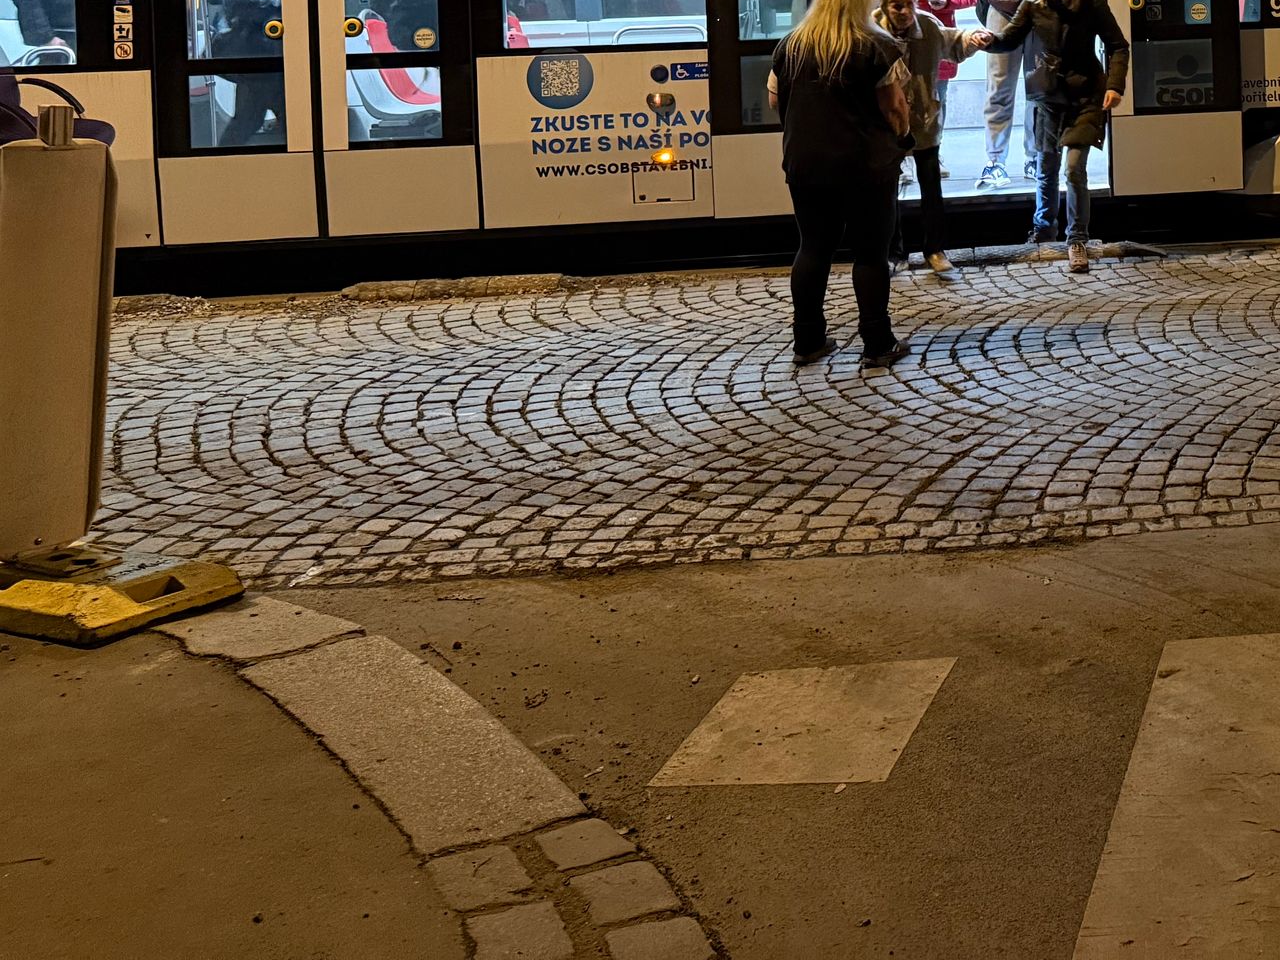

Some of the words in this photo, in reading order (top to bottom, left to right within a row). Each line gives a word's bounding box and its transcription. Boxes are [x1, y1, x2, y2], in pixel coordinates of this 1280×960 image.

[530, 113, 615, 133] ZKUSTE
[620, 110, 650, 129] TO
[654, 109, 686, 127] NA
[532, 136, 592, 155] NOZE
[597, 136, 611, 152] S
[617, 129, 673, 150] NAŠÍ
[680, 131, 710, 148] PO
